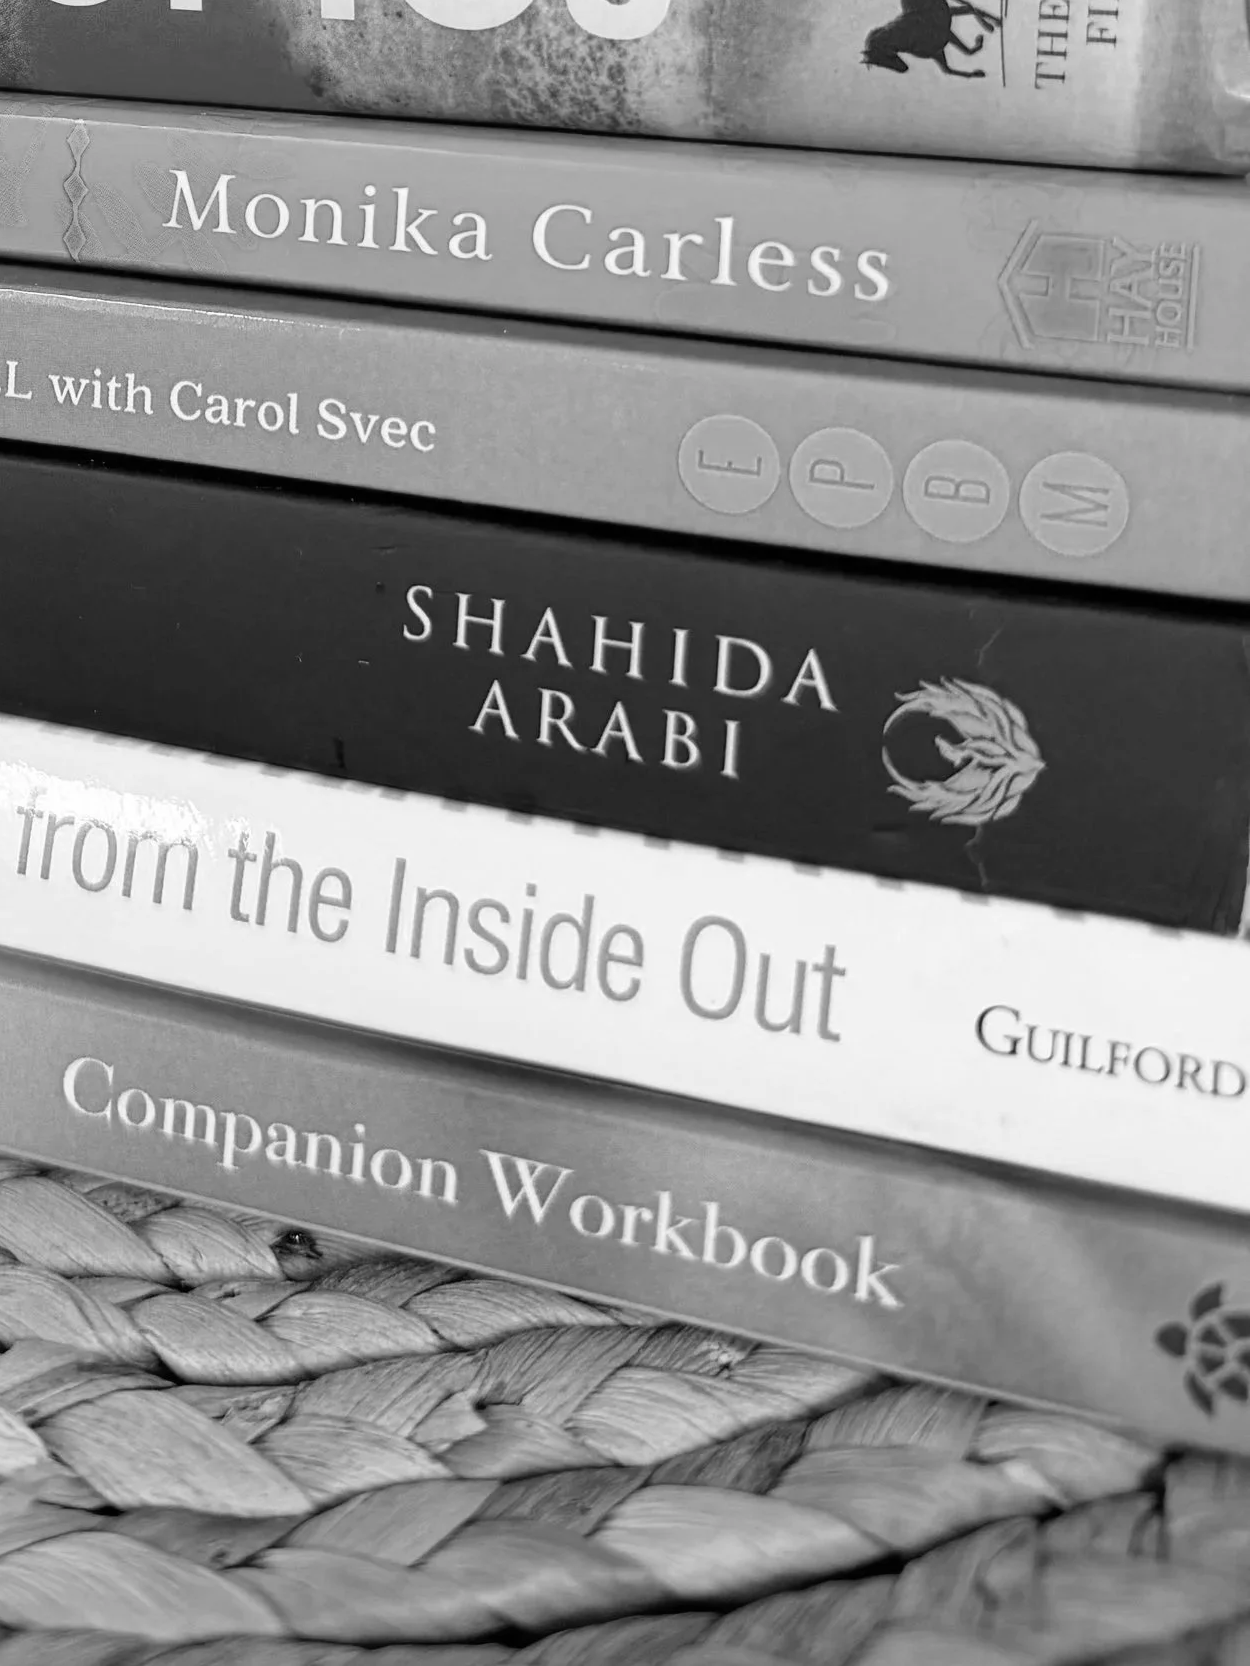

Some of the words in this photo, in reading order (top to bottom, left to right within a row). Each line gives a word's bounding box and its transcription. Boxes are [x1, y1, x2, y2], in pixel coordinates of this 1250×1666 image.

[1035, 0, 1070, 90] THE
[163, 169, 493, 261] Monika
[531, 202, 892, 301] Carless
[1106, 237, 1158, 346] HAY
[1154, 241, 1188, 348] HOUSE
[48, 367, 152, 415] with
[169, 380, 300, 436] Carol
[316, 398, 436, 453] Svec
[404, 584, 839, 712] SHAHIDA
[468, 679, 741, 779] ARABI
[17, 786, 199, 911] from
[228, 830, 353, 944] the
[384, 857, 645, 1002] Inside
[679, 914, 848, 1043] Out
[973, 1004, 1248, 1098] GUILFORD
[63, 1055, 459, 1206] Companion
[479, 1148, 905, 1310] Workbook
